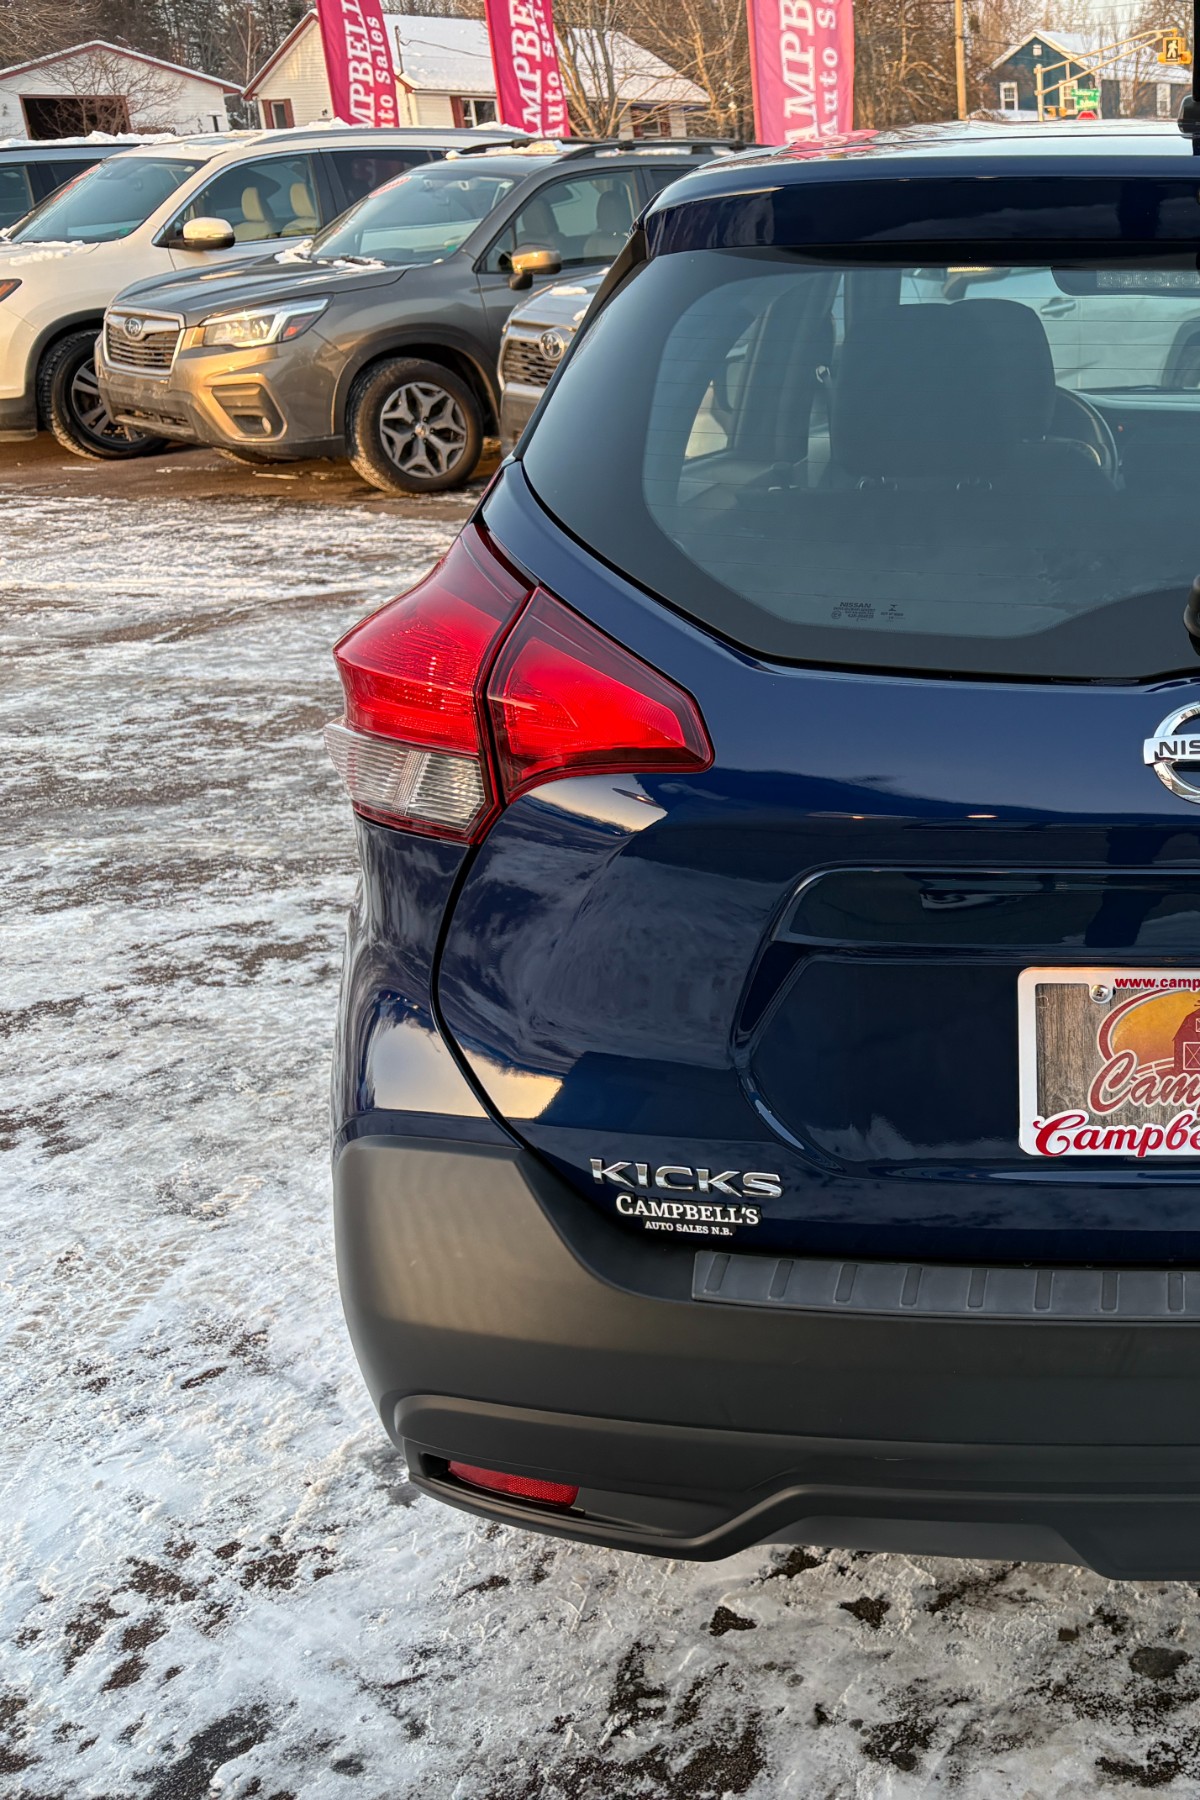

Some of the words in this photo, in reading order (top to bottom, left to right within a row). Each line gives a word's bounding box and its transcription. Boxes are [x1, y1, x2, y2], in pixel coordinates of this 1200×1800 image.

[366, 16, 391, 84] Sales
[820, 46, 838, 136] Auto
[590, 1158, 784, 1198] KICKS
[616, 1195, 759, 1225] CAMPBELL'S
[645, 1221, 674, 1231] AUTO
[676, 1223, 709, 1234] SALES
[711, 1226, 733, 1236] N.B.
